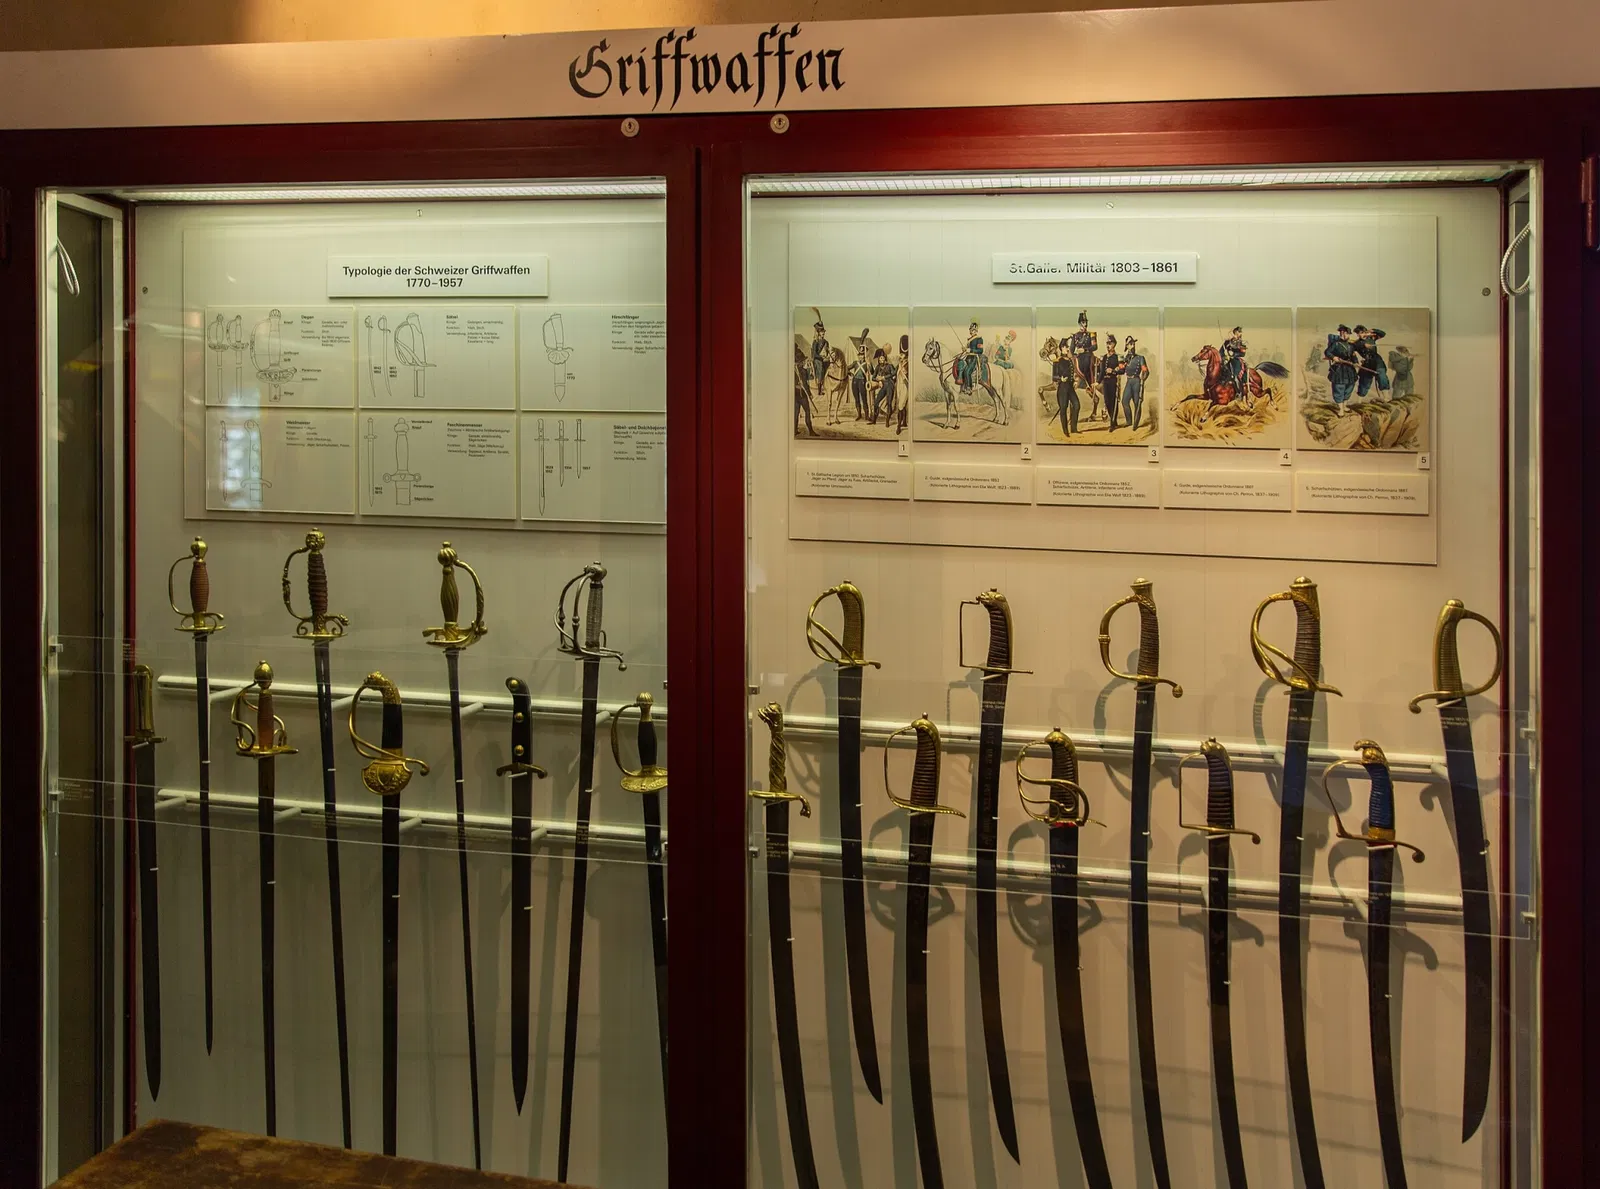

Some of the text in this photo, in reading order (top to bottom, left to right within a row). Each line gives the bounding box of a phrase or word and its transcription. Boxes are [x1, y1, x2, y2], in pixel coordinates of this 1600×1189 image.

[569, 23, 845, 111] Griffwaffen
[343, 265, 530, 277] Typologie der Schweizer Griffwaffen
